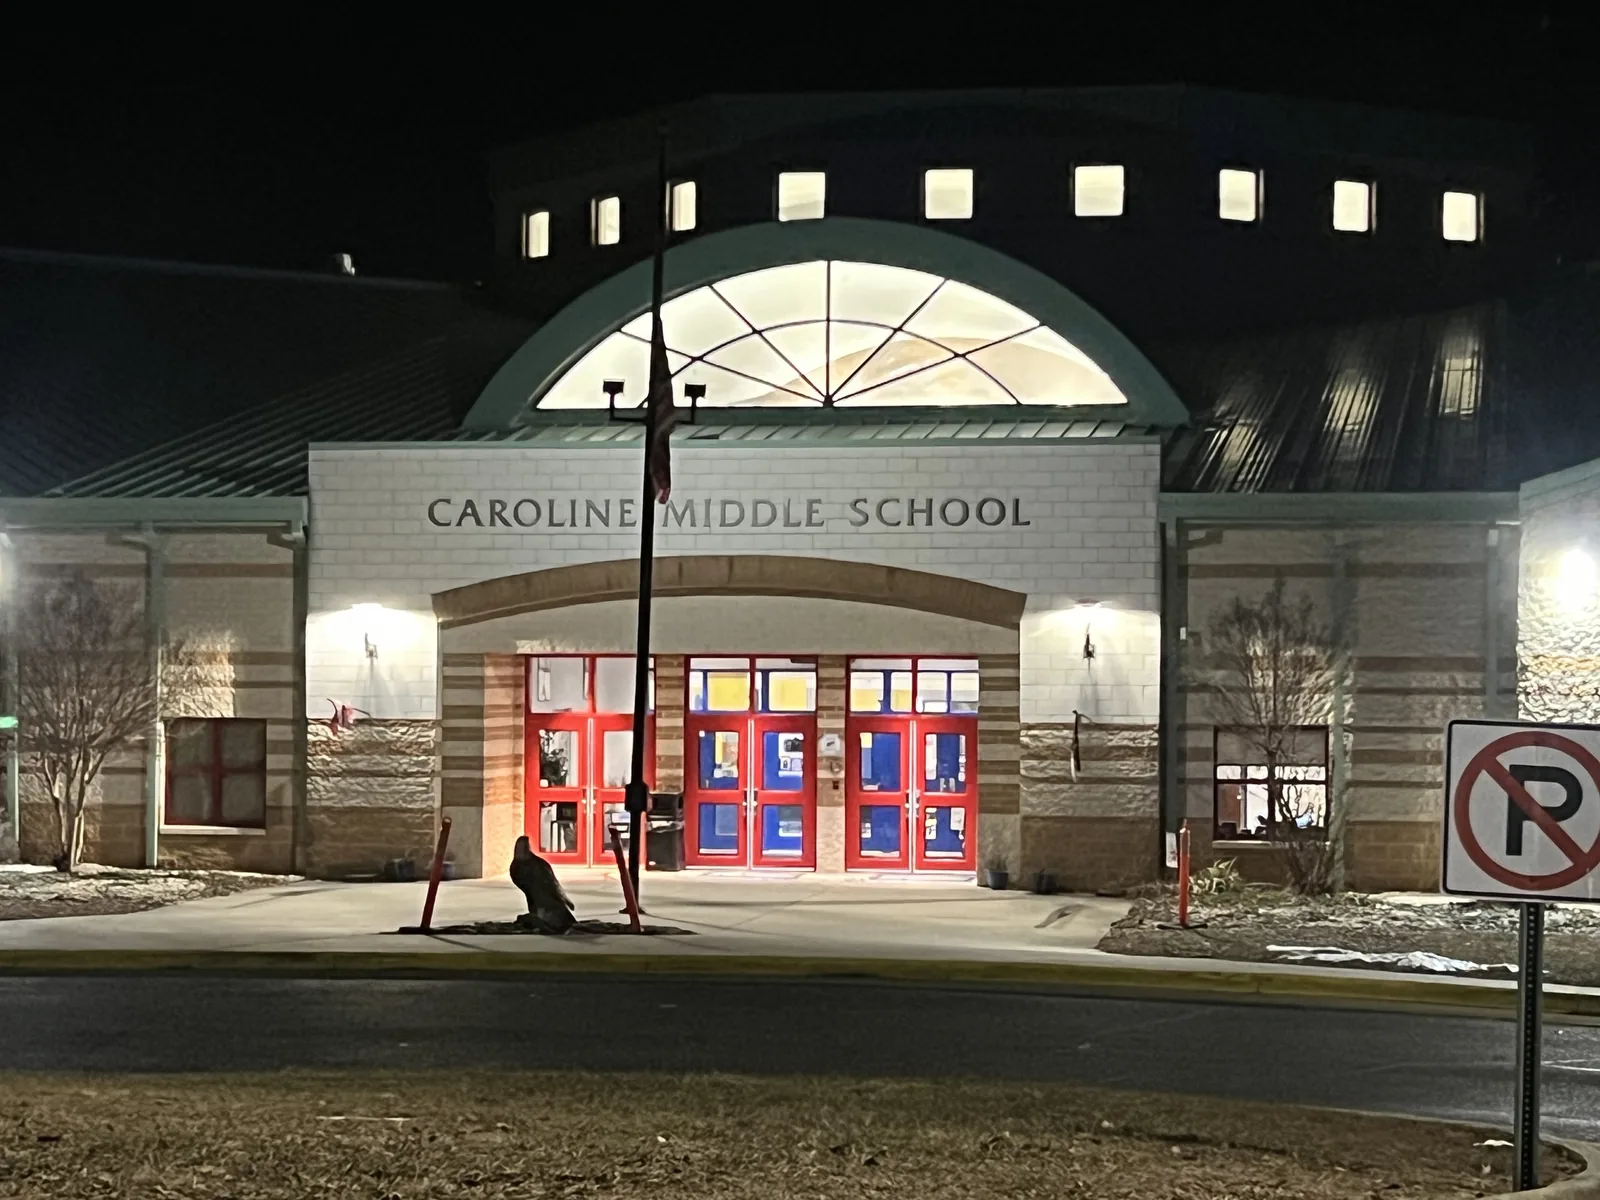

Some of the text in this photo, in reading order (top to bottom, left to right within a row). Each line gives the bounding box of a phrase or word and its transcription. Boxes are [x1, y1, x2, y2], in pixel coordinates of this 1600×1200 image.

[427, 498, 1032, 528] CAROLINE MIDDLE SCHOOL
[1505, 764, 1583, 856] P
